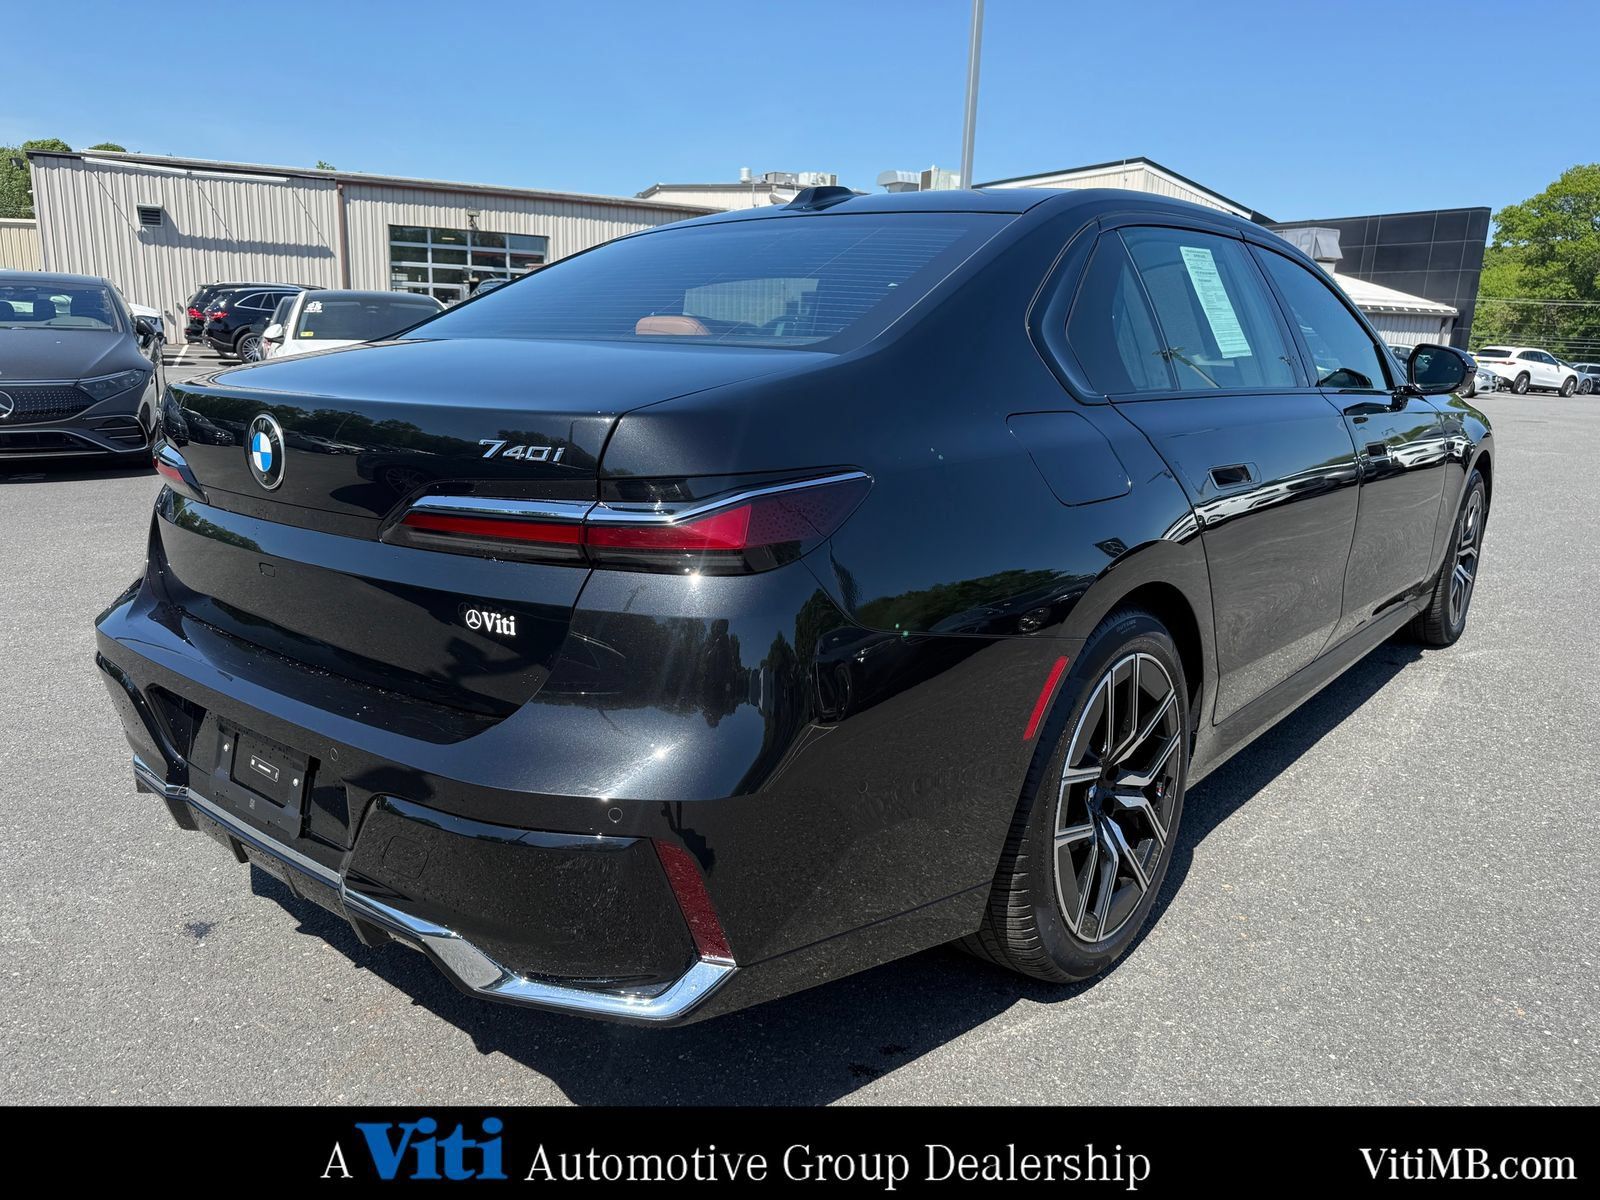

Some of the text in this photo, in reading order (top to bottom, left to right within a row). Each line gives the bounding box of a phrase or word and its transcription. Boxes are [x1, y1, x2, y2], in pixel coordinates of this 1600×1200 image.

[250, 418, 279, 443] BMW
[479, 439, 565, 462] 740i
[481, 611, 516, 636] Viti
